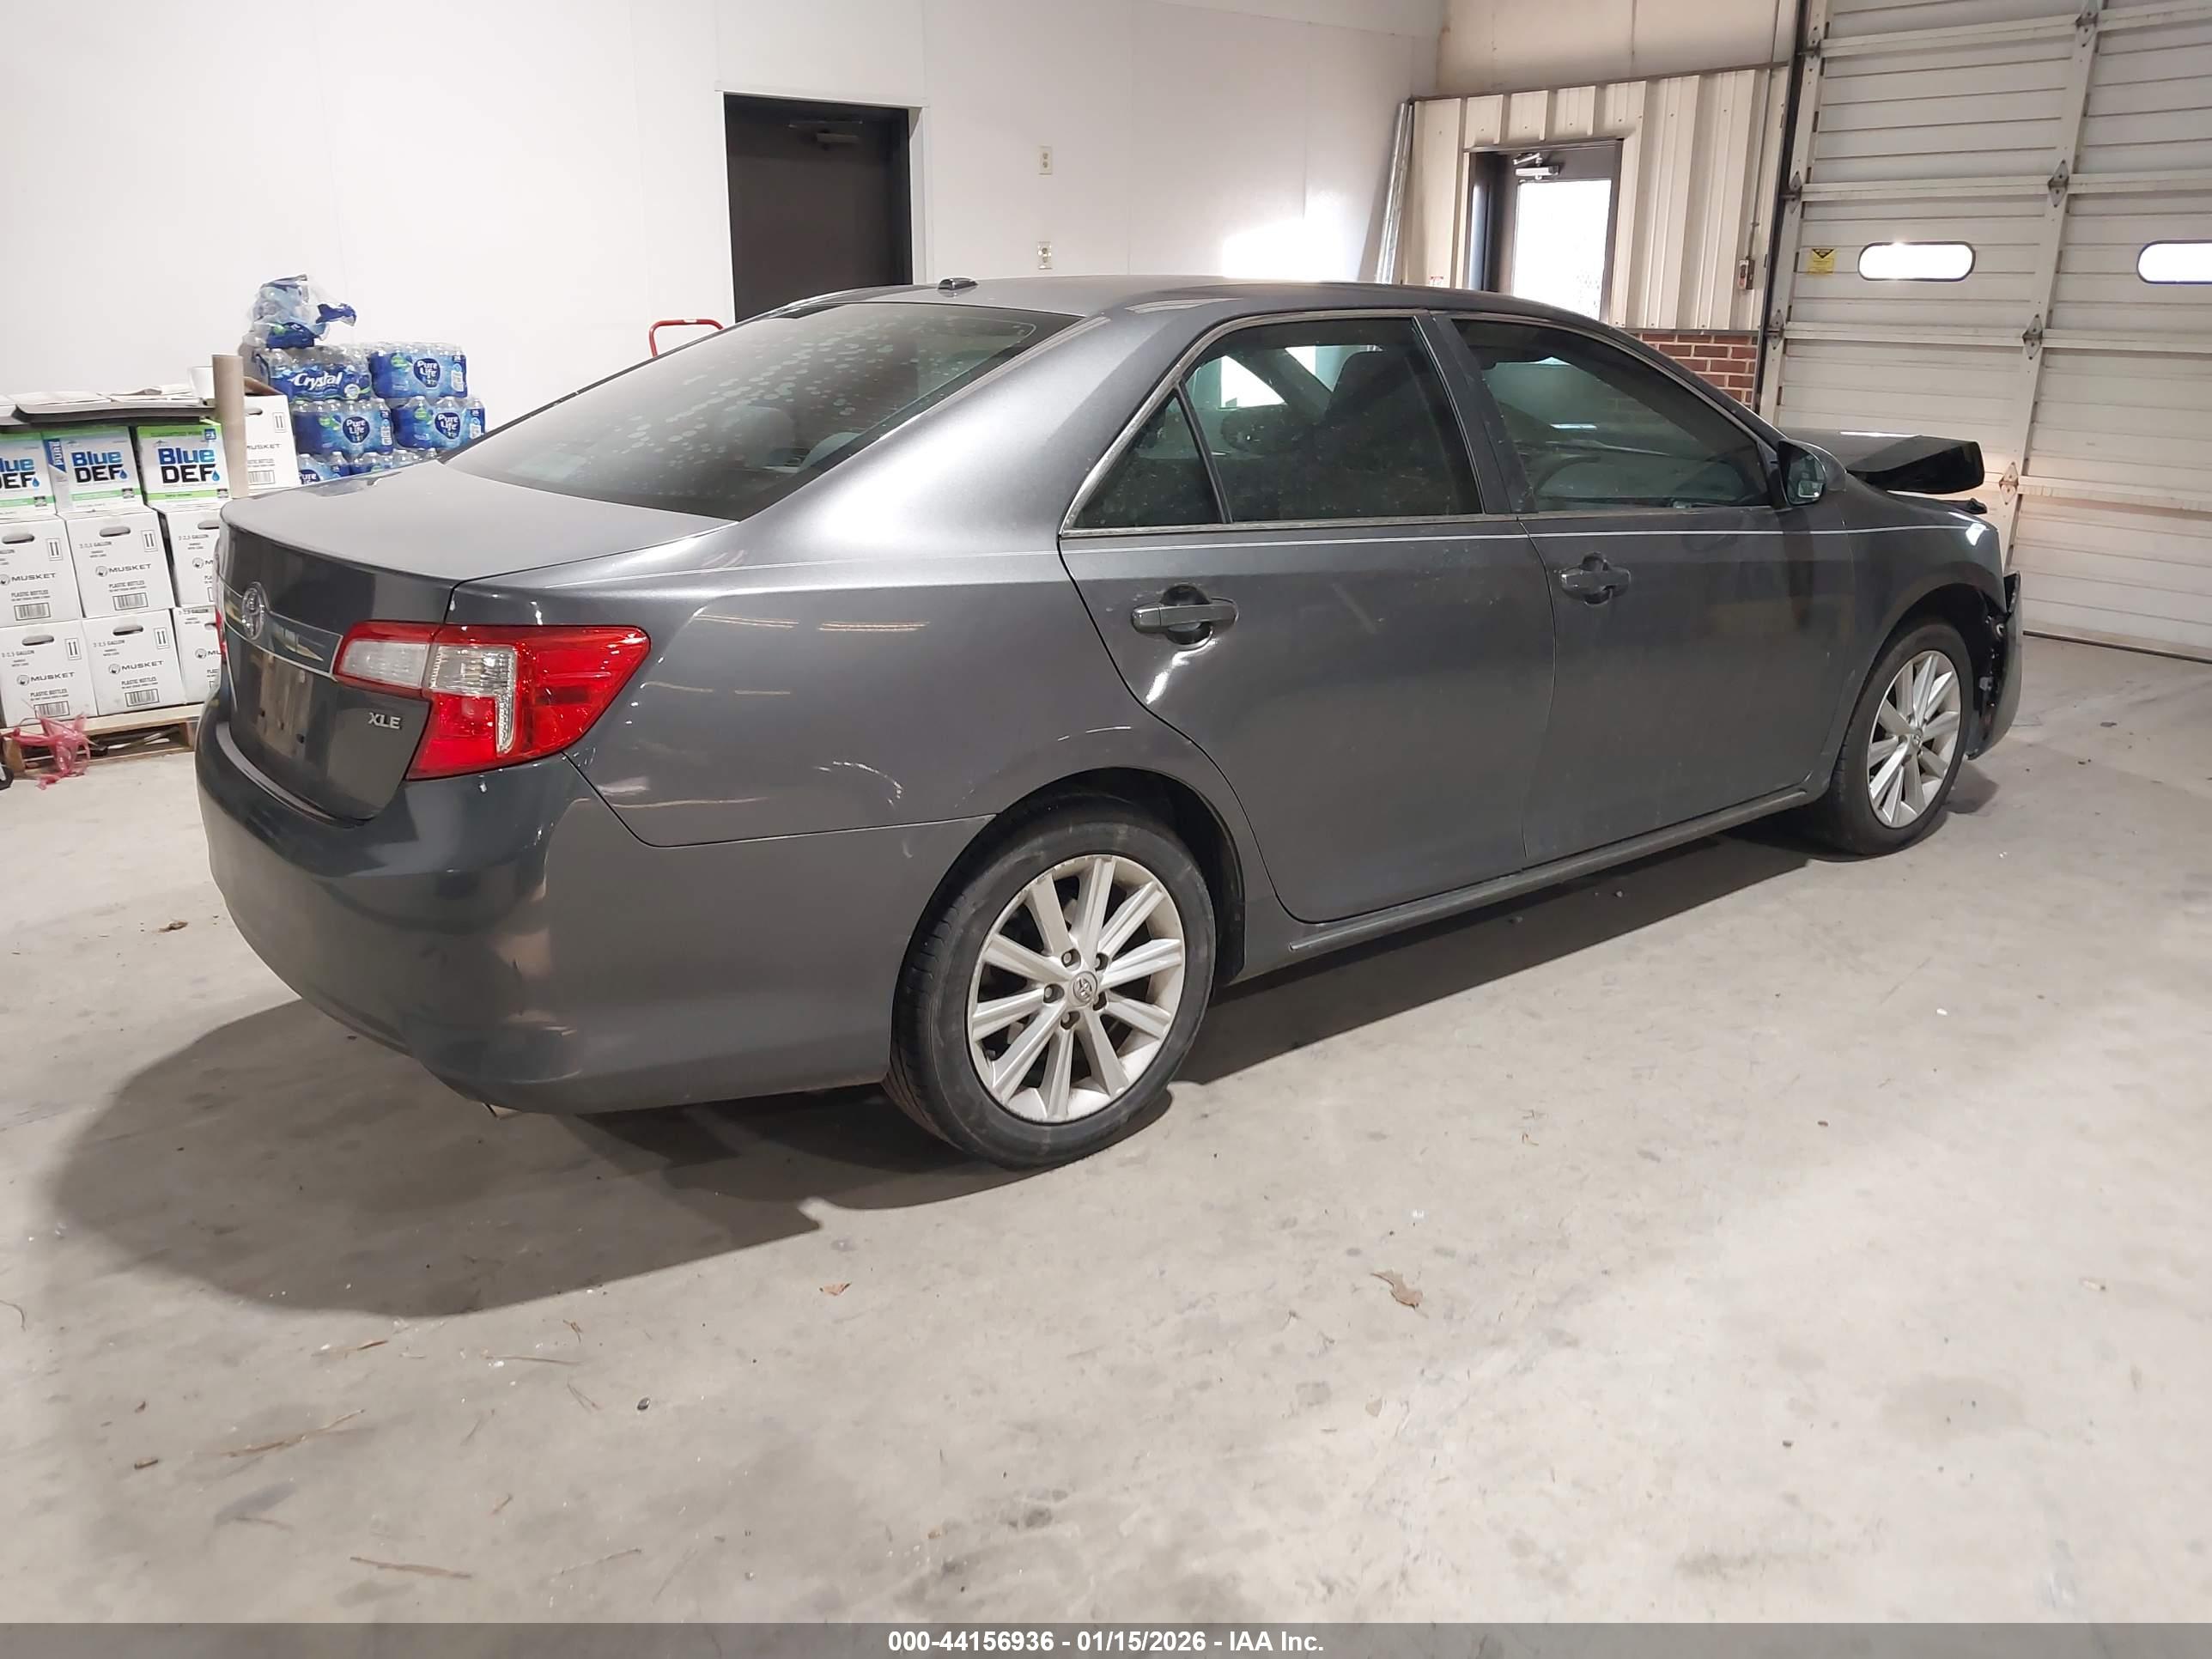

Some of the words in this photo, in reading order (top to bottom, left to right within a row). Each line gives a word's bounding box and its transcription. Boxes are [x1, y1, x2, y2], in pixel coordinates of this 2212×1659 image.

[417, 360, 438, 369] Pure
[419, 367, 437, 378] Life
[294, 371, 343, 391] Crystal
[438, 412, 459, 422] Pure
[441, 420, 457, 431] Life
[71, 451, 123, 466] Blue
[158, 447, 216, 465] Blue
[0, 458, 34, 472] lue
[75, 464, 124, 483] DEF
[161, 464, 216, 483] DEF
[0, 471, 36, 489] EF
[109, 563, 151, 573] MUSKET
[11, 573, 56, 581] MUSKET
[122, 660, 164, 671] MUSKET
[31, 672, 75, 682] MUSKET
[368, 712, 401, 729] XLE
